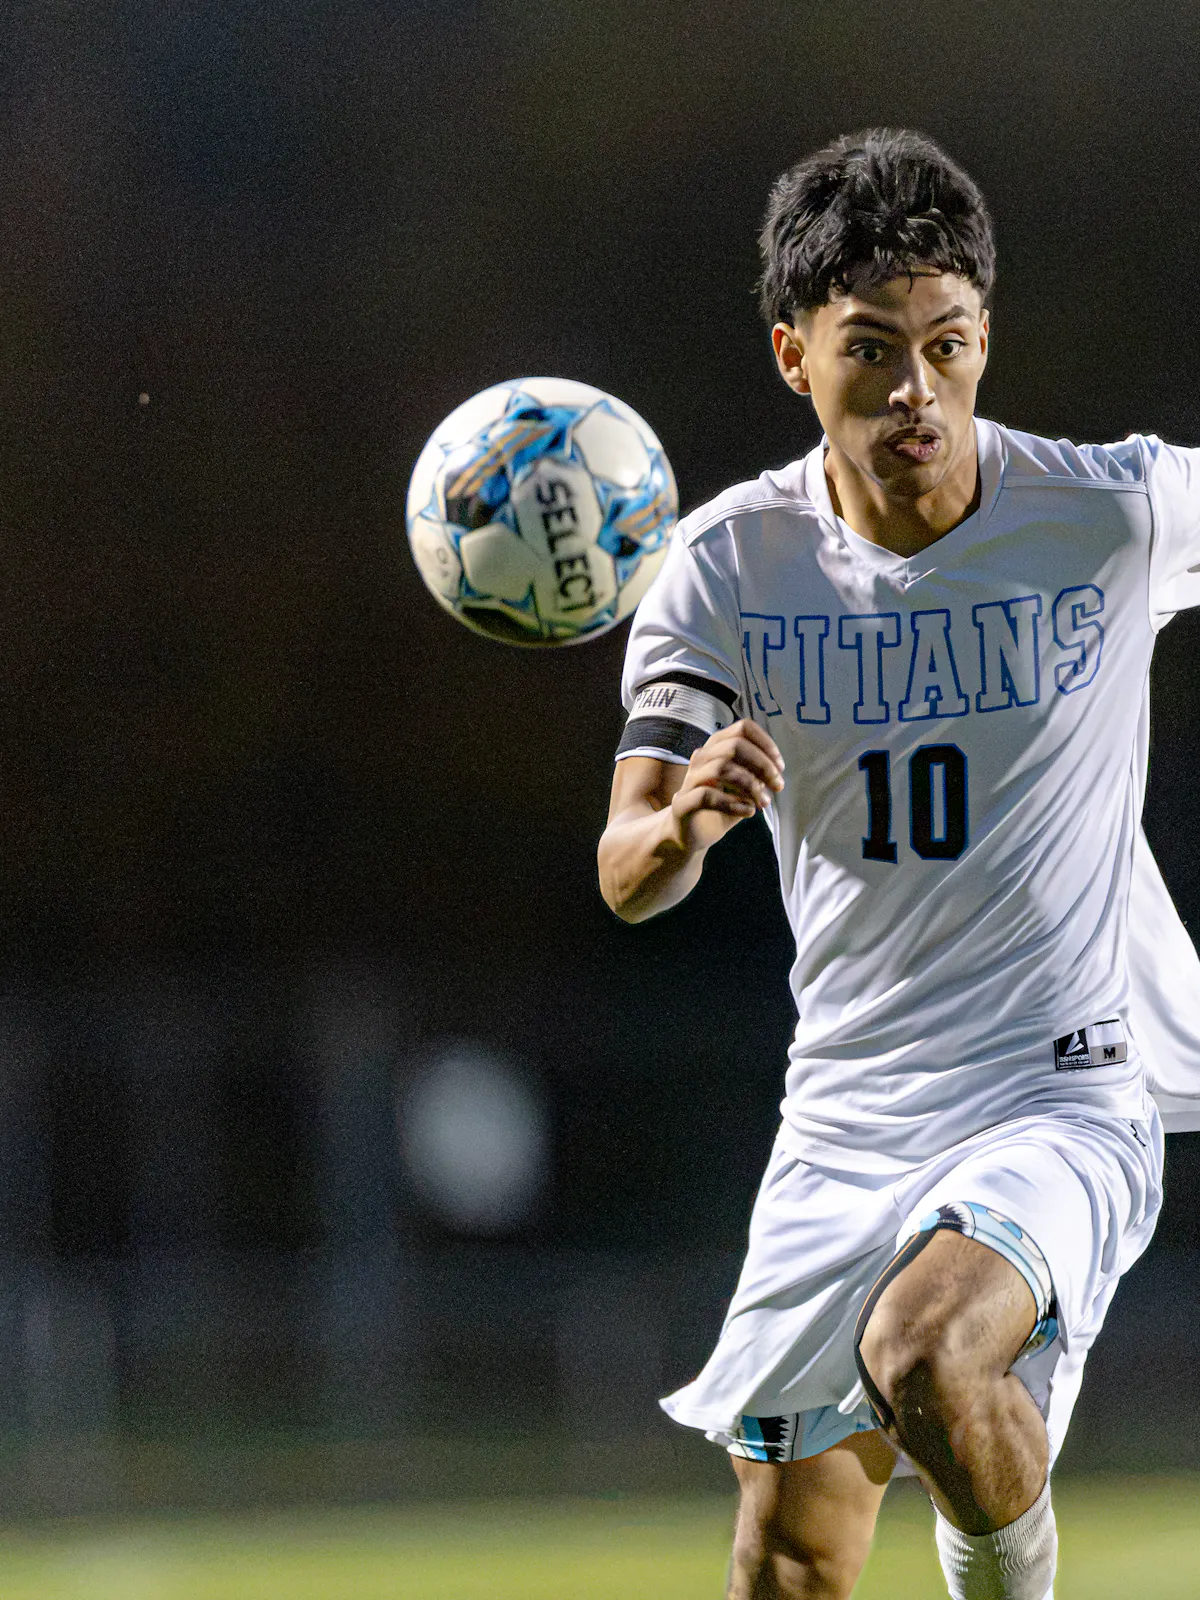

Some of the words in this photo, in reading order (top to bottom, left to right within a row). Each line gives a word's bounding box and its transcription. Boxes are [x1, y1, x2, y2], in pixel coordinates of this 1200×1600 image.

[740, 583, 1106, 725] TITANS
[857, 742, 970, 864] 10
[1103, 1046, 1116, 1059] M
